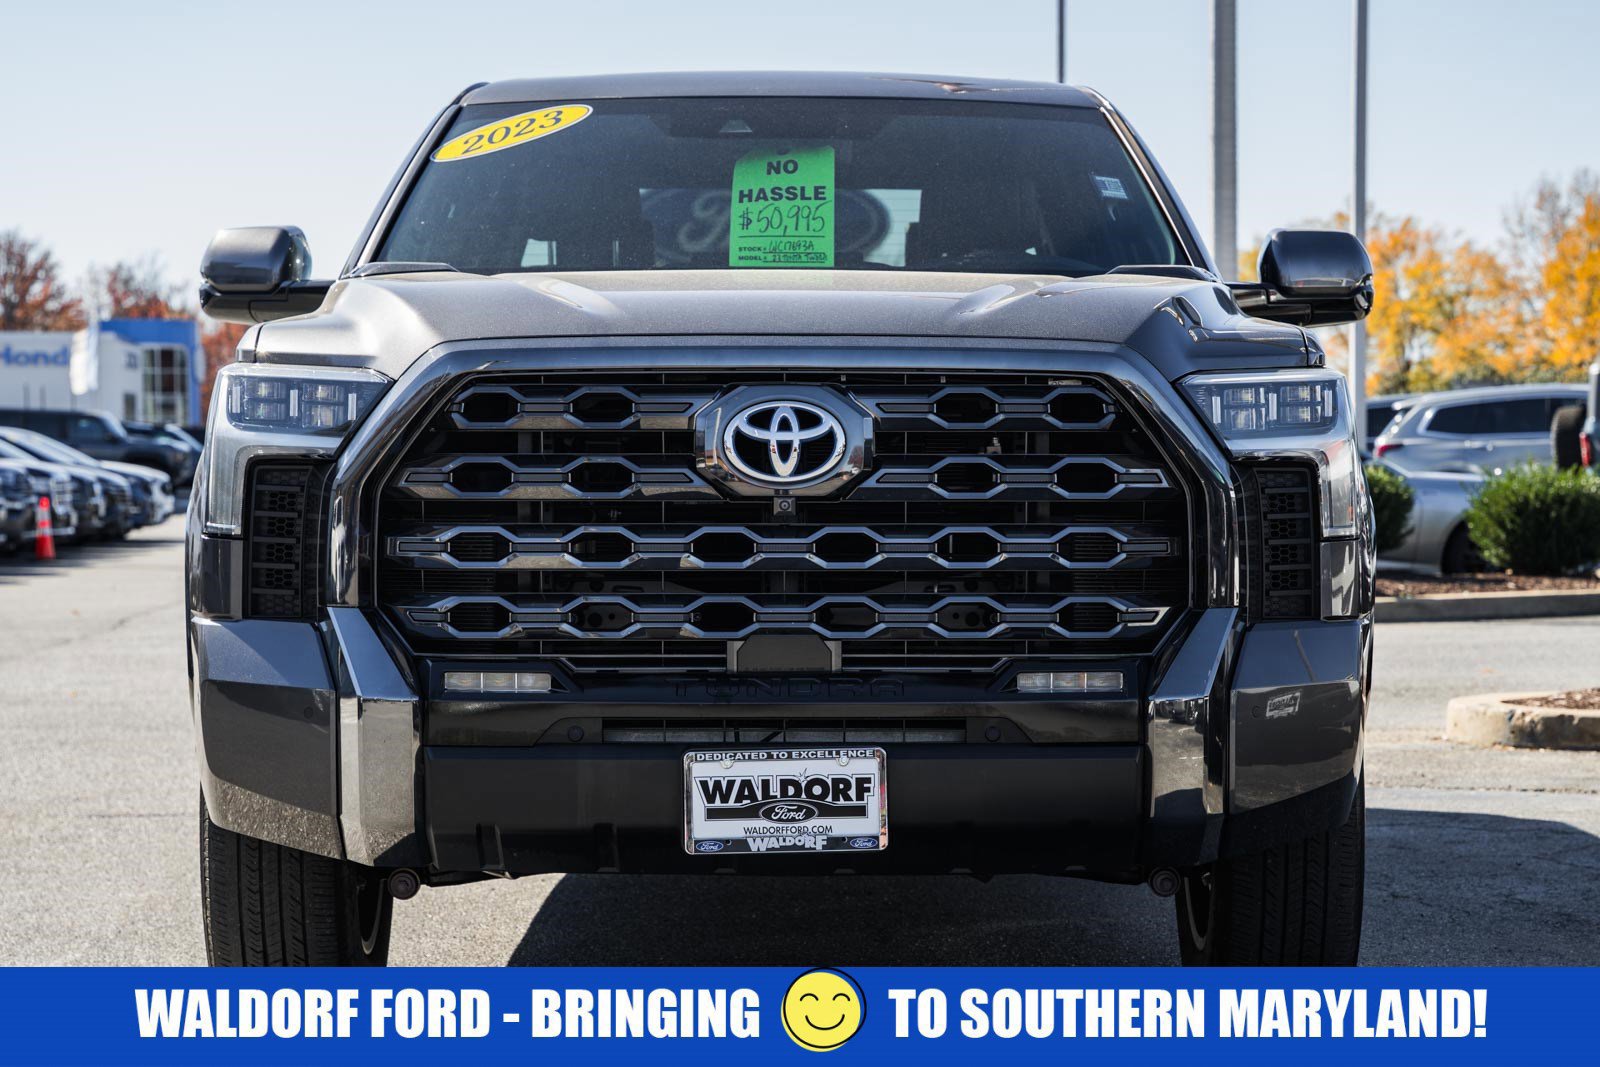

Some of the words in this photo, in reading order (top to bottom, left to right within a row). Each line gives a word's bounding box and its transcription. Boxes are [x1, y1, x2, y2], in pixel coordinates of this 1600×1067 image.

[461, 110, 564, 155] 2023
[766, 159, 799, 175] NO
[738, 186, 827, 203] HASSLE
[0, 344, 69, 367] ond
[664, 677, 906, 698] TUNDRA
[696, 751, 768, 761] DEDICATED
[771, 751, 788, 760] TO
[791, 749, 874, 760] EXCELLENCE
[697, 774, 874, 806] WALDORF
[770, 804, 806, 821] Ford
[743, 825, 833, 836] WALDORFFORD.COM
[746, 835, 829, 852] WALDORF
